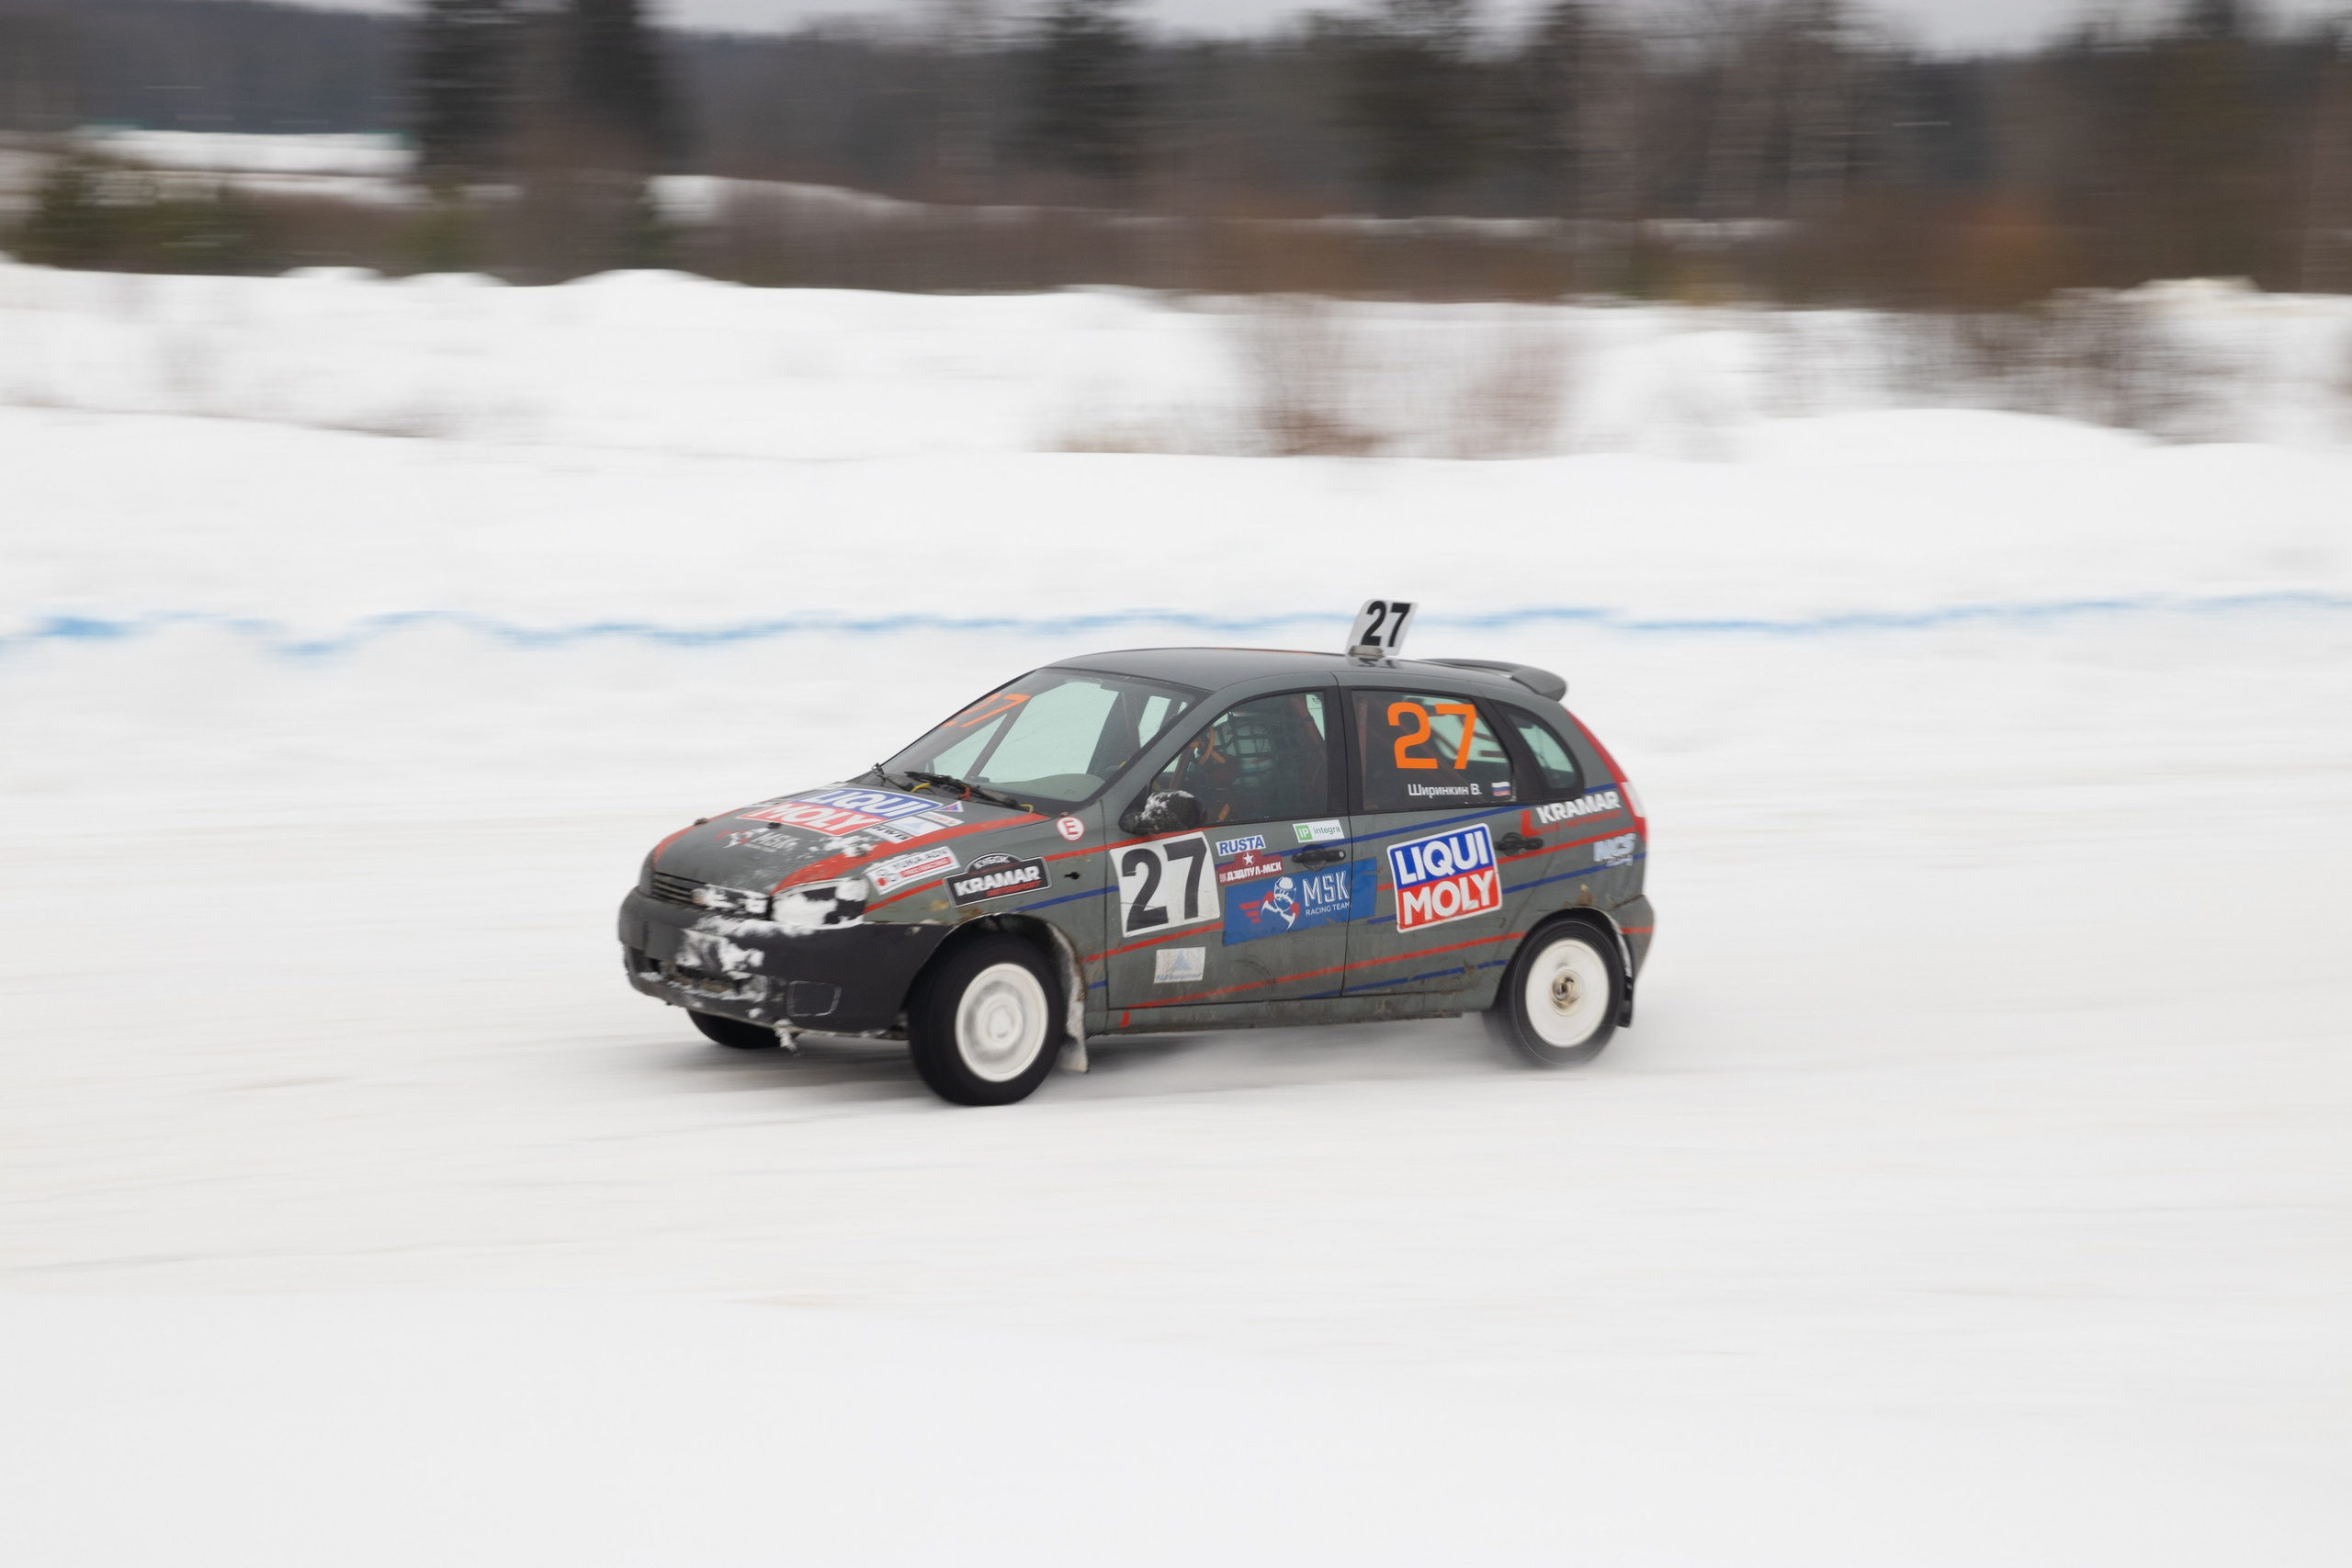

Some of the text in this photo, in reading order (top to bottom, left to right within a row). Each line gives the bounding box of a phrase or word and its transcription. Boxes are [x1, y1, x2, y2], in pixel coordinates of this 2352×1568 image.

[1360, 601, 1411, 647] 27
[1387, 702, 1476, 769] 27
[799, 790, 933, 818] LIQUI
[1408, 784, 1483, 798] Ширинкин В.
[747, 803, 885, 831] MOLY
[1536, 792, 1622, 823] KRAMAR
[1063, 820, 1079, 835] E
[1298, 826, 1341, 838] IP integra
[1218, 837, 1265, 854] RUSTA
[1395, 830, 1489, 885] LIQUI
[954, 865, 1041, 897] KRAMAR
[1122, 837, 1207, 932] 27
[1303, 870, 1349, 907] MSK
[1306, 905, 1331, 917] RACING
[1402, 870, 1494, 925] MOLY
